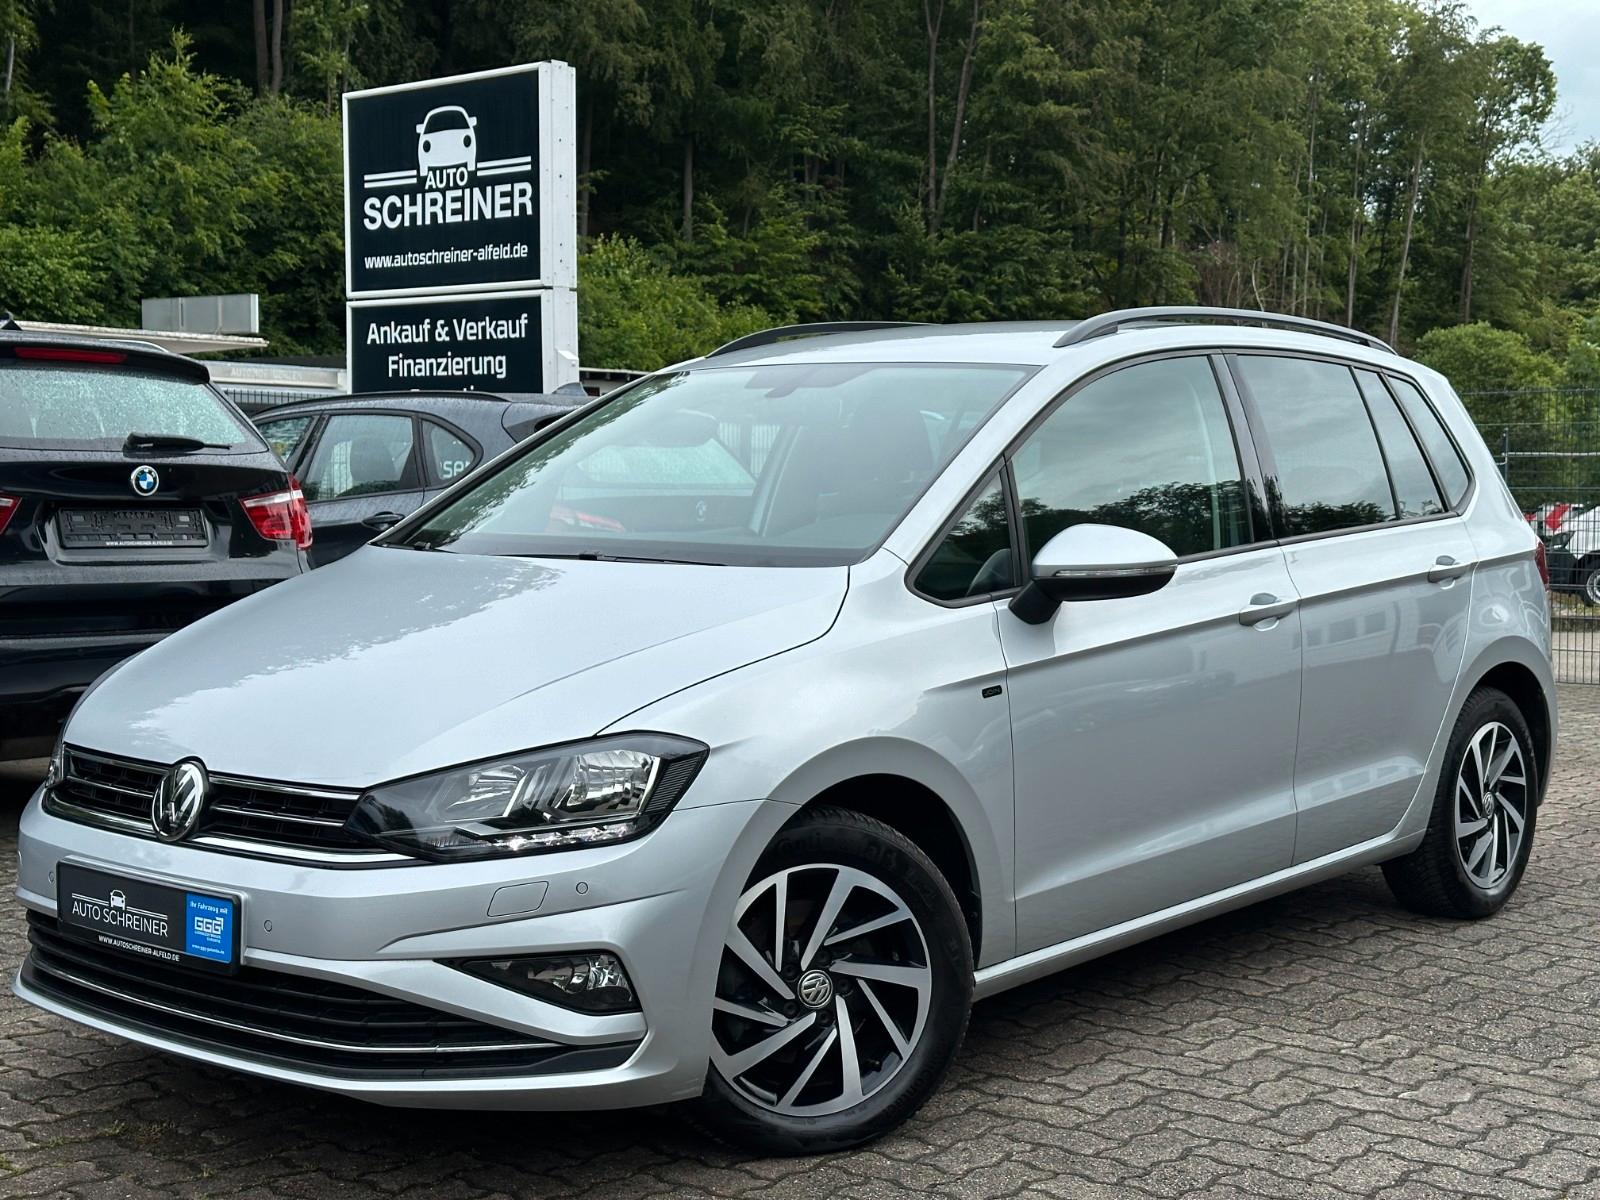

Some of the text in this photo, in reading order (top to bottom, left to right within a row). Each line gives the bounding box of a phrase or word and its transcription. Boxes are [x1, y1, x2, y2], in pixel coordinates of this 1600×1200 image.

[425, 167, 468, 190] AUTO
[363, 182, 533, 231] SCHREINER
[364, 242, 528, 269] www.autoschreiner-alfeld.de
[367, 313, 528, 345] Ankauf & Verkauf
[388, 352, 507, 379] Finanzierung
[71, 901, 169, 938] AUTO SCHREINER
[98, 934, 180, 962] WWW.AUTOSCHREINER-ALFELD.DE
